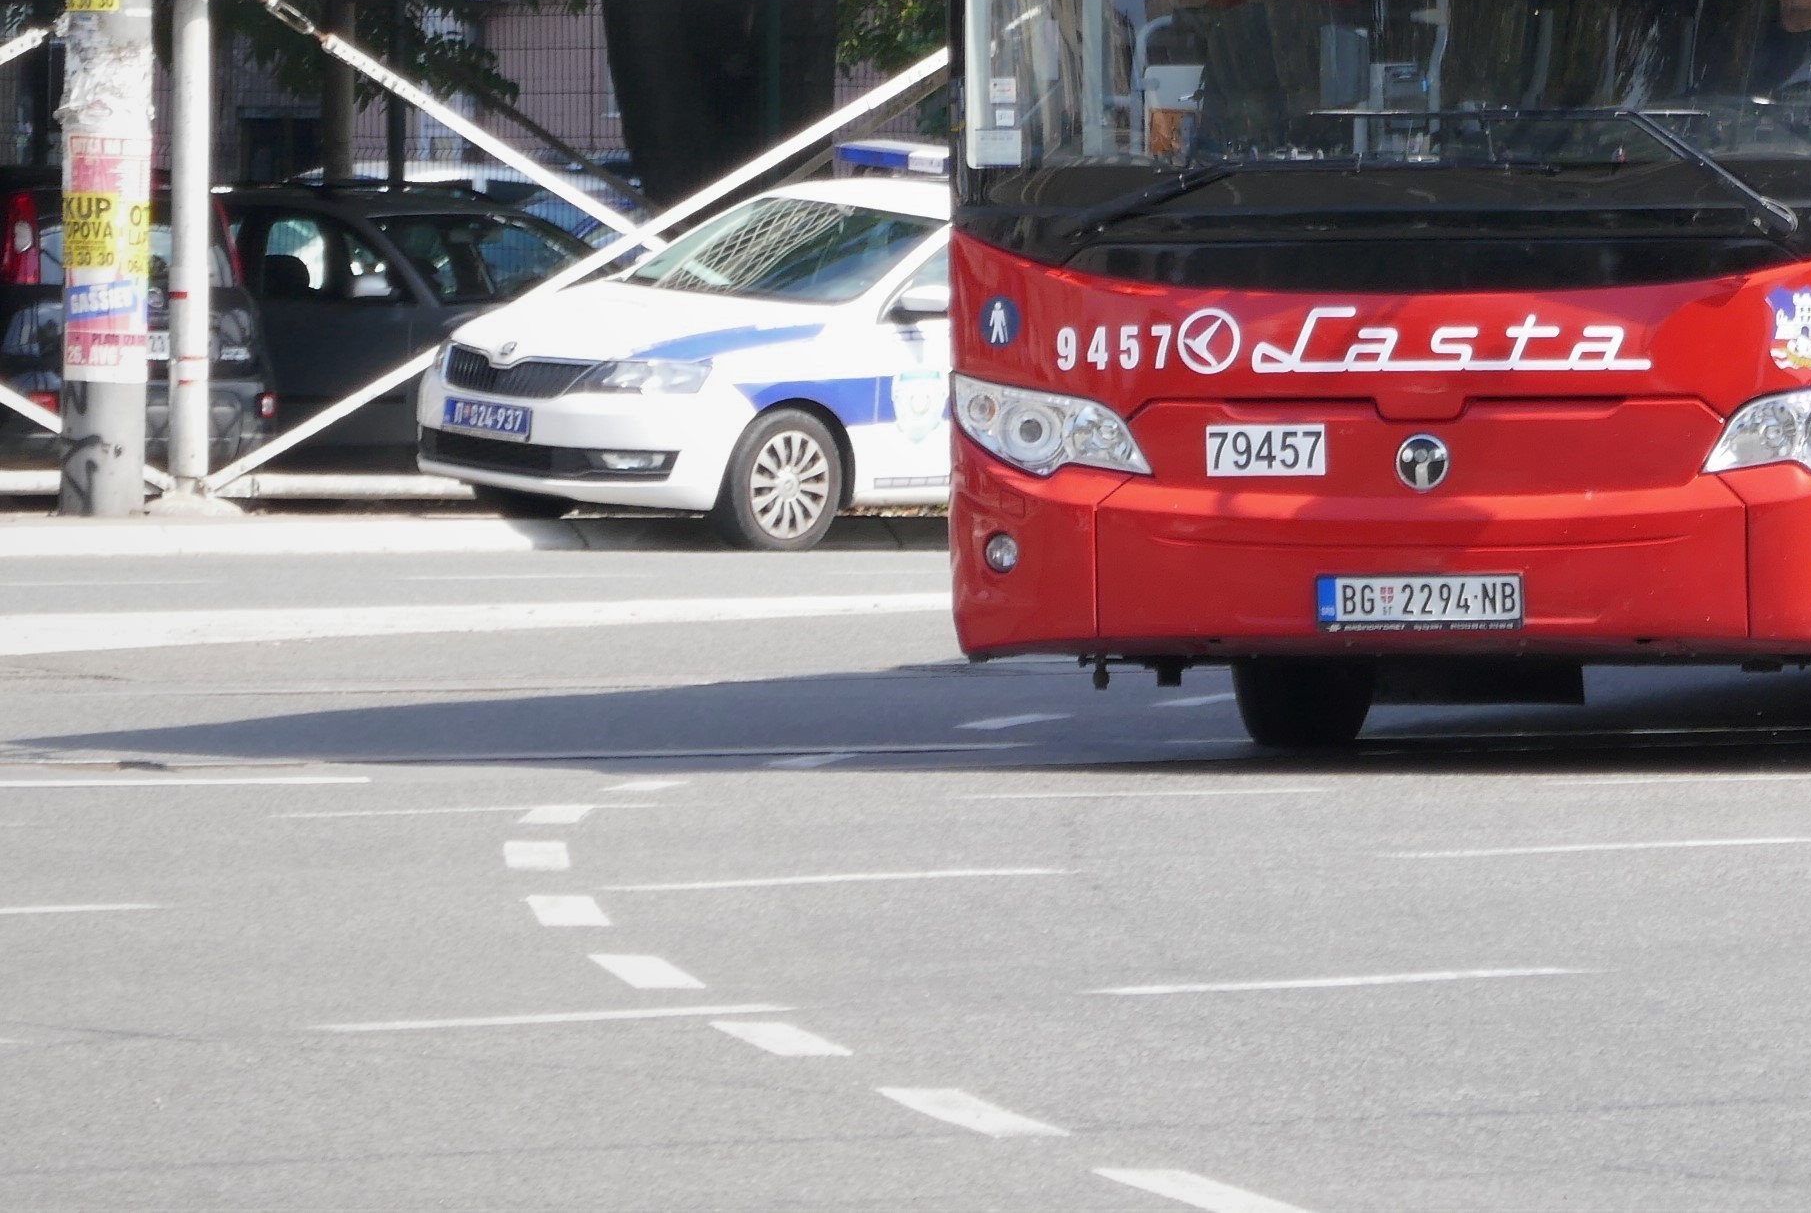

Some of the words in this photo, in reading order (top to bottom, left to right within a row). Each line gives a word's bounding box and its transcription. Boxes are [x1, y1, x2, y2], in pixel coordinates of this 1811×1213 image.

[1057, 324, 1172, 371] 9457
[1252, 306, 1652, 373] Lasta
[1208, 430, 1323, 470] 79457
[1342, 584, 1376, 615] BG
